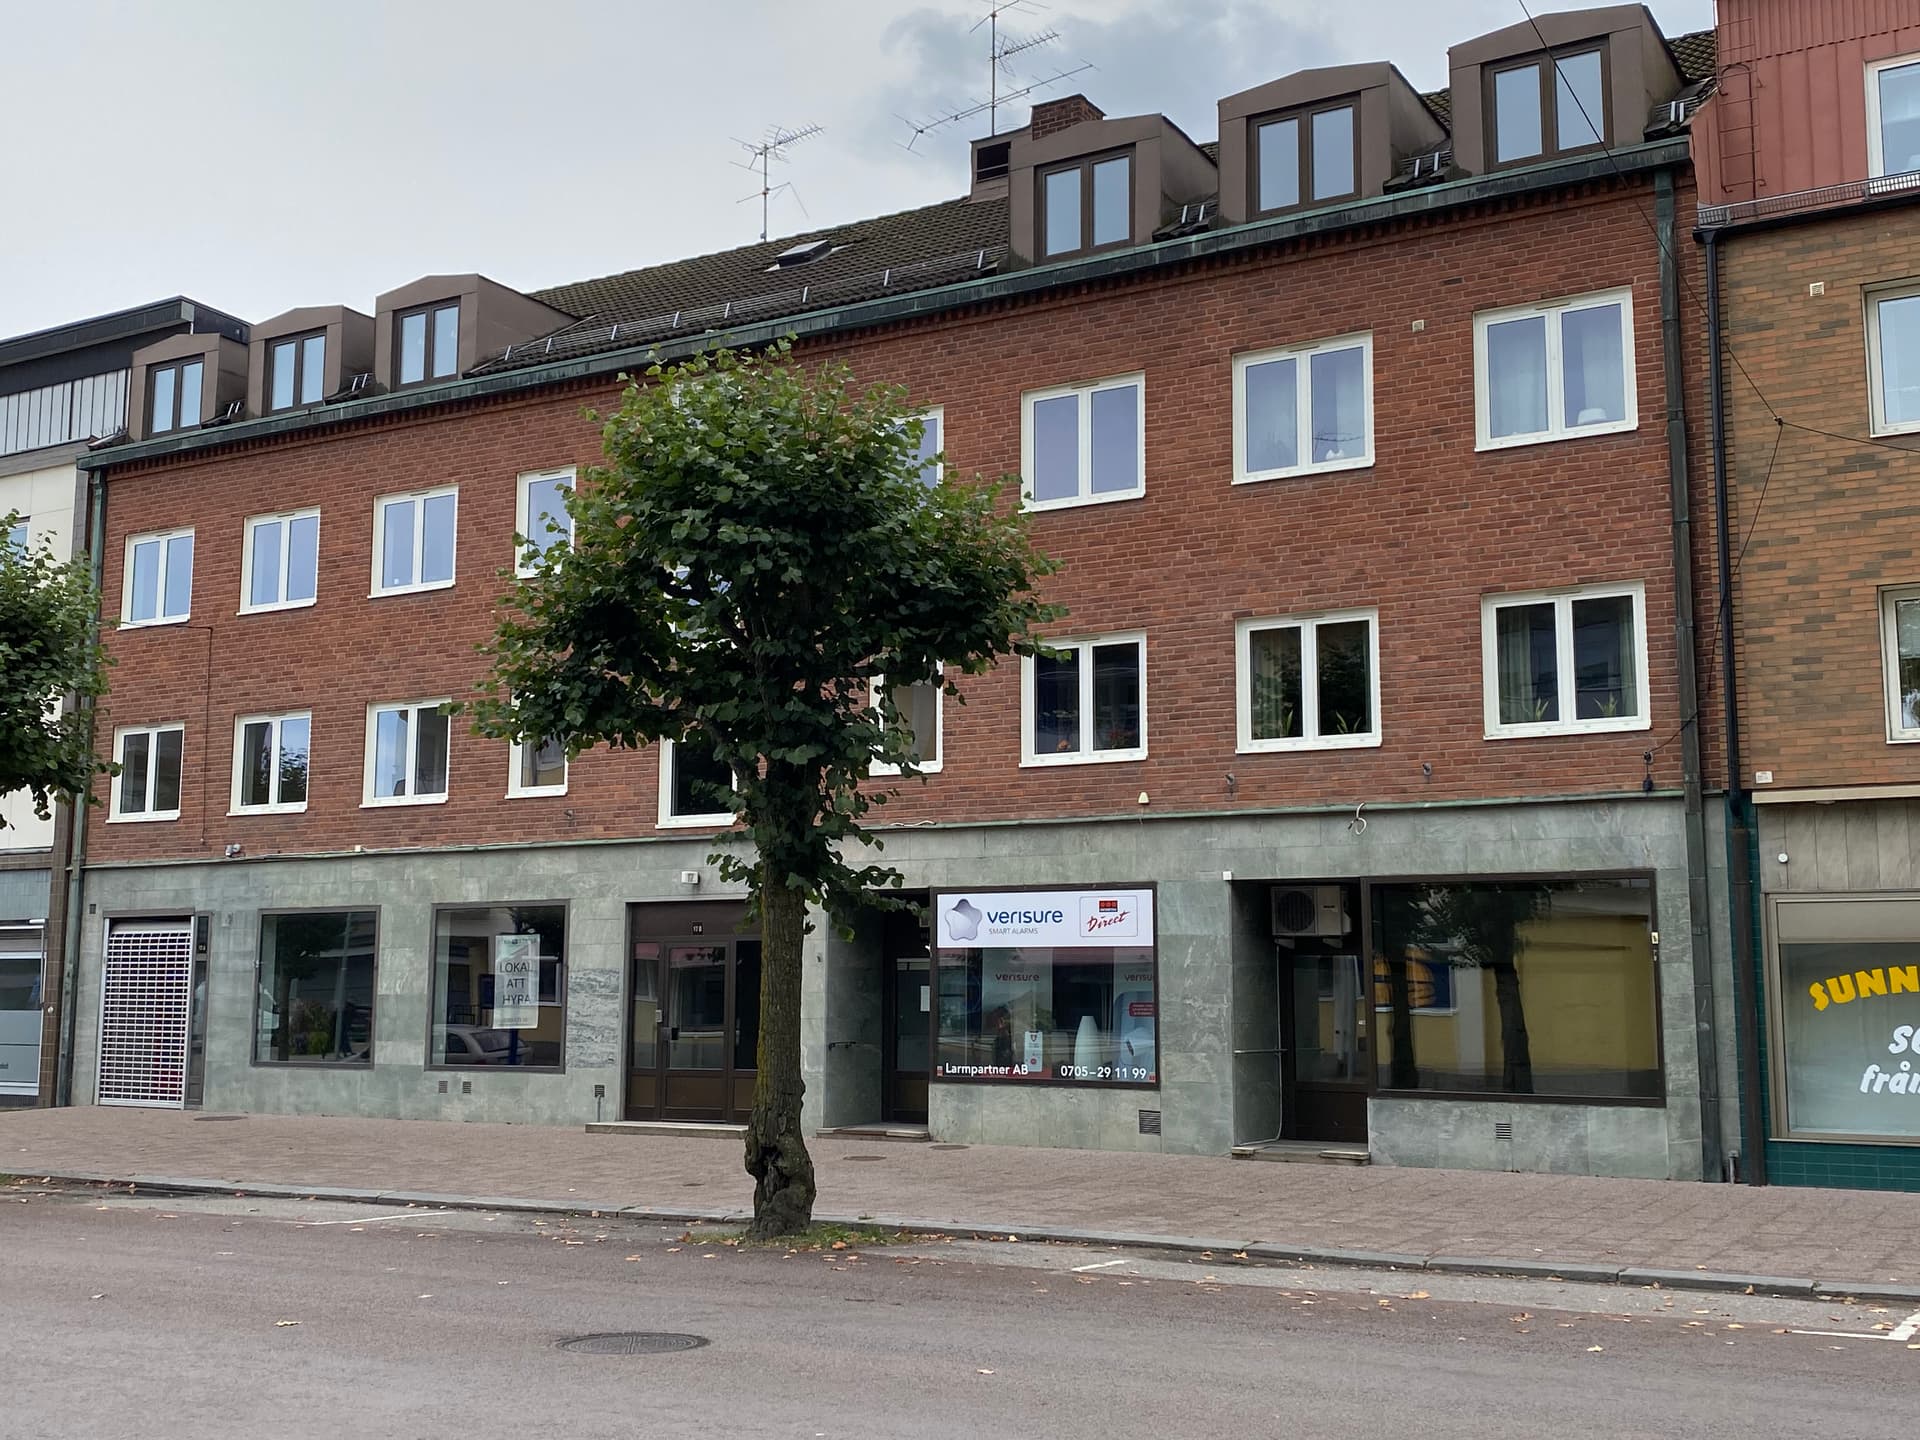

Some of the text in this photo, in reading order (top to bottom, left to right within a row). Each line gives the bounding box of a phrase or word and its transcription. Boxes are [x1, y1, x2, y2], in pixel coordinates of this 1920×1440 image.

[987, 910, 1063, 924] verisure
[1087, 911, 1130, 932] Direct
[507, 978, 525, 989] ATT
[995, 974, 1040, 982] verisure
[1809, 965, 1920, 1012] SUNN
[502, 994, 531, 1005] HYRA
[945, 1062, 1029, 1077] Larmpartner AB
[1114, 1067, 1128, 1079] 11
[1131, 1067, 1147, 1079] 99
